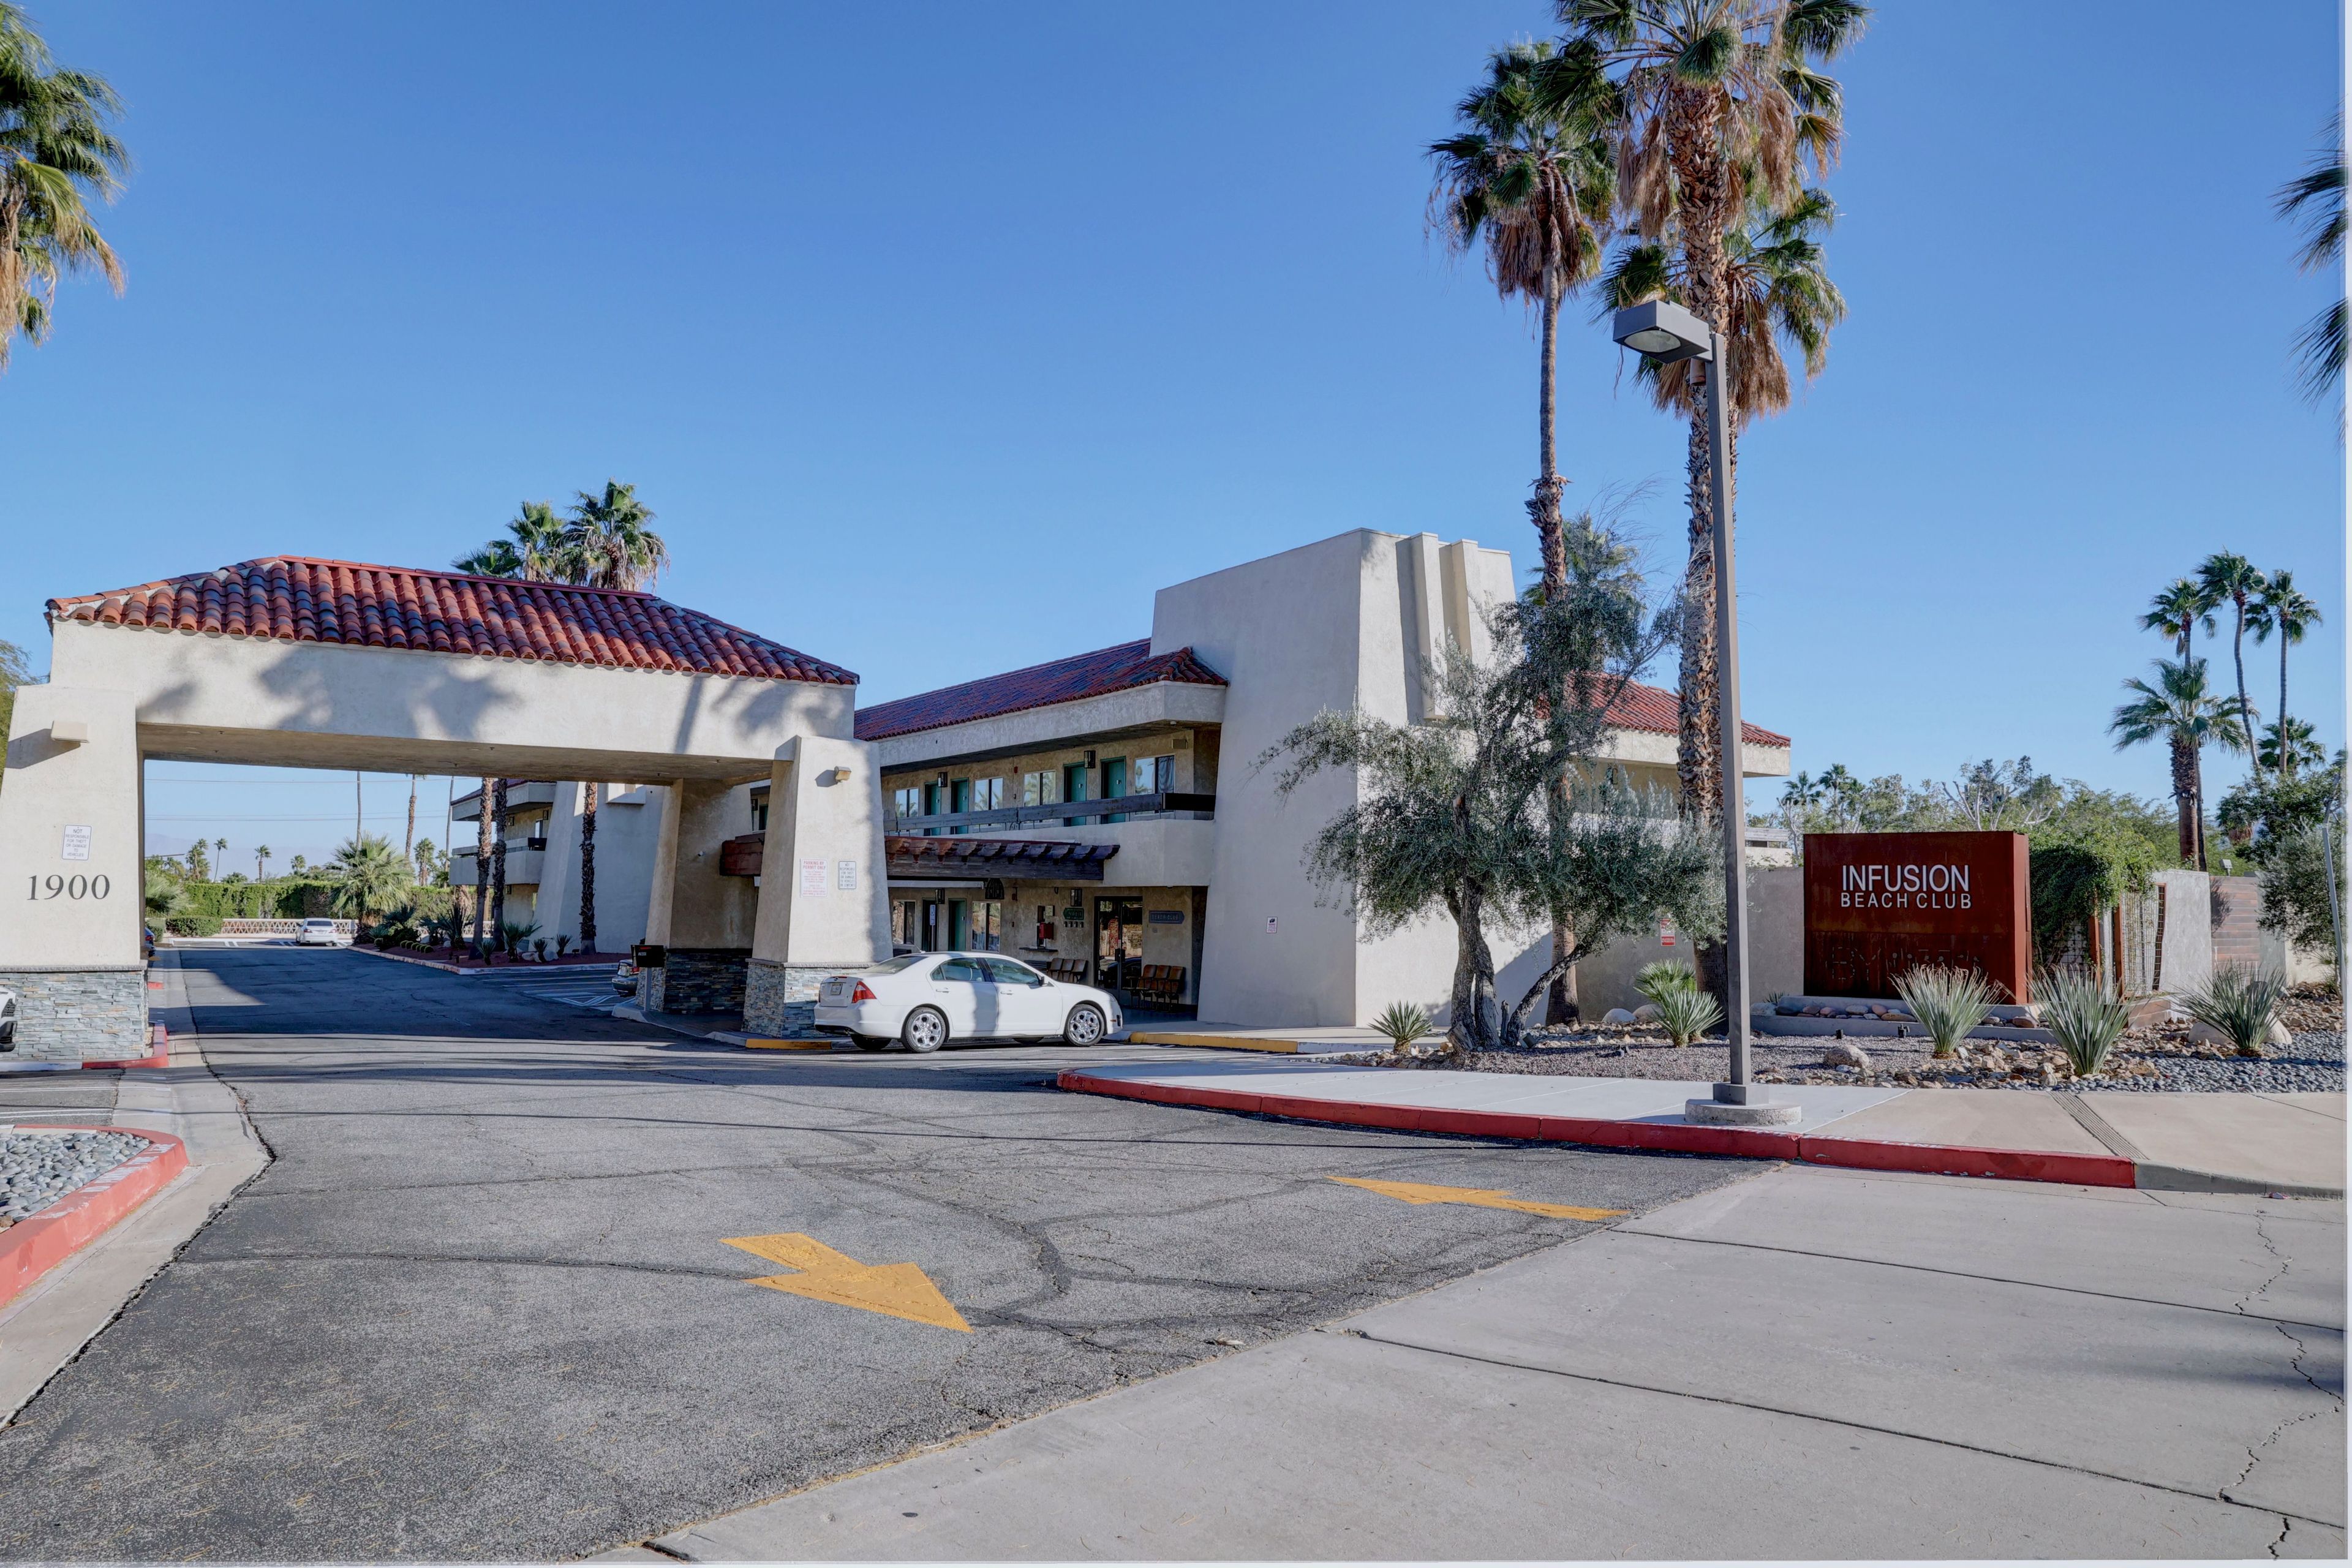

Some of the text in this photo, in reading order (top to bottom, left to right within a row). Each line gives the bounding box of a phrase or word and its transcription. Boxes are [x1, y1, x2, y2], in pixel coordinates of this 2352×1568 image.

[26, 874, 110, 900] 1900
[1842, 864, 1969, 892] INFUSION
[1841, 892, 1972, 909] BEACH CLUB
